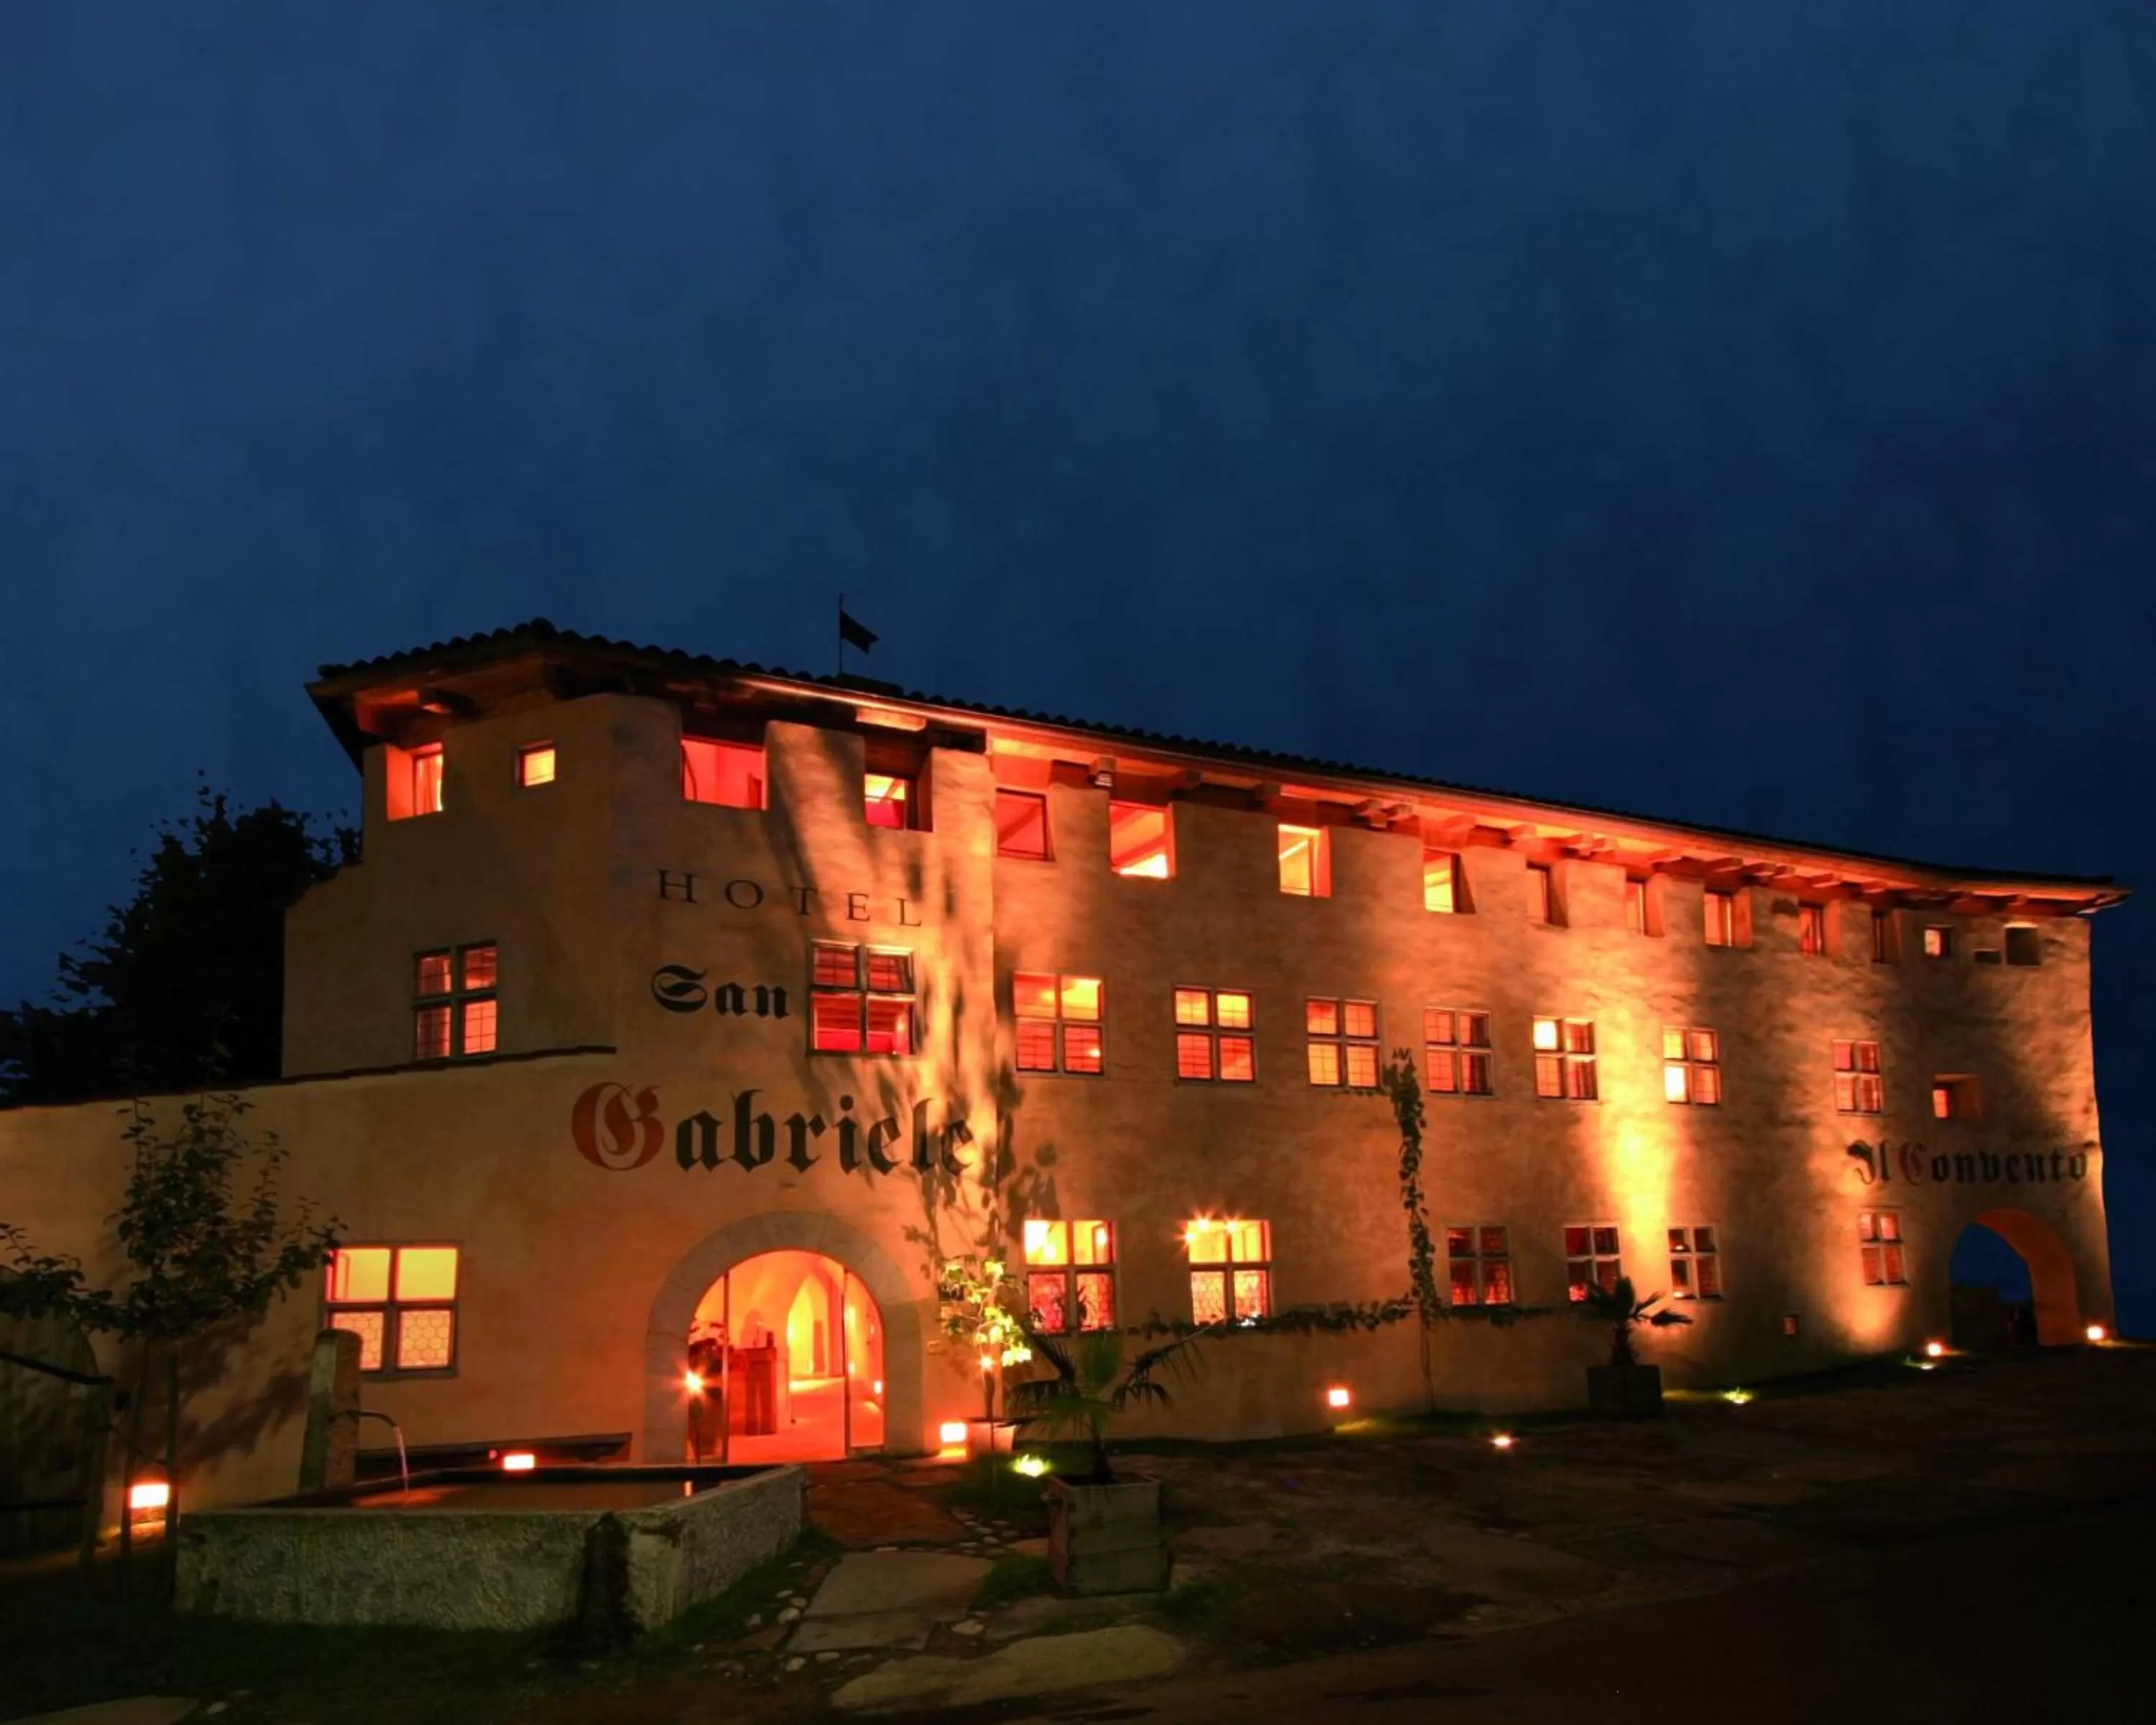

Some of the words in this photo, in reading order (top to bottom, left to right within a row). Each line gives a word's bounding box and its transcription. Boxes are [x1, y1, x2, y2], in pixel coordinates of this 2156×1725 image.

[657, 869, 922, 927] HOTEL
[651, 965, 790, 1019] San
[571, 1082, 975, 1174] Gabriele
[1899, 1141, 2088, 1185] Convento
